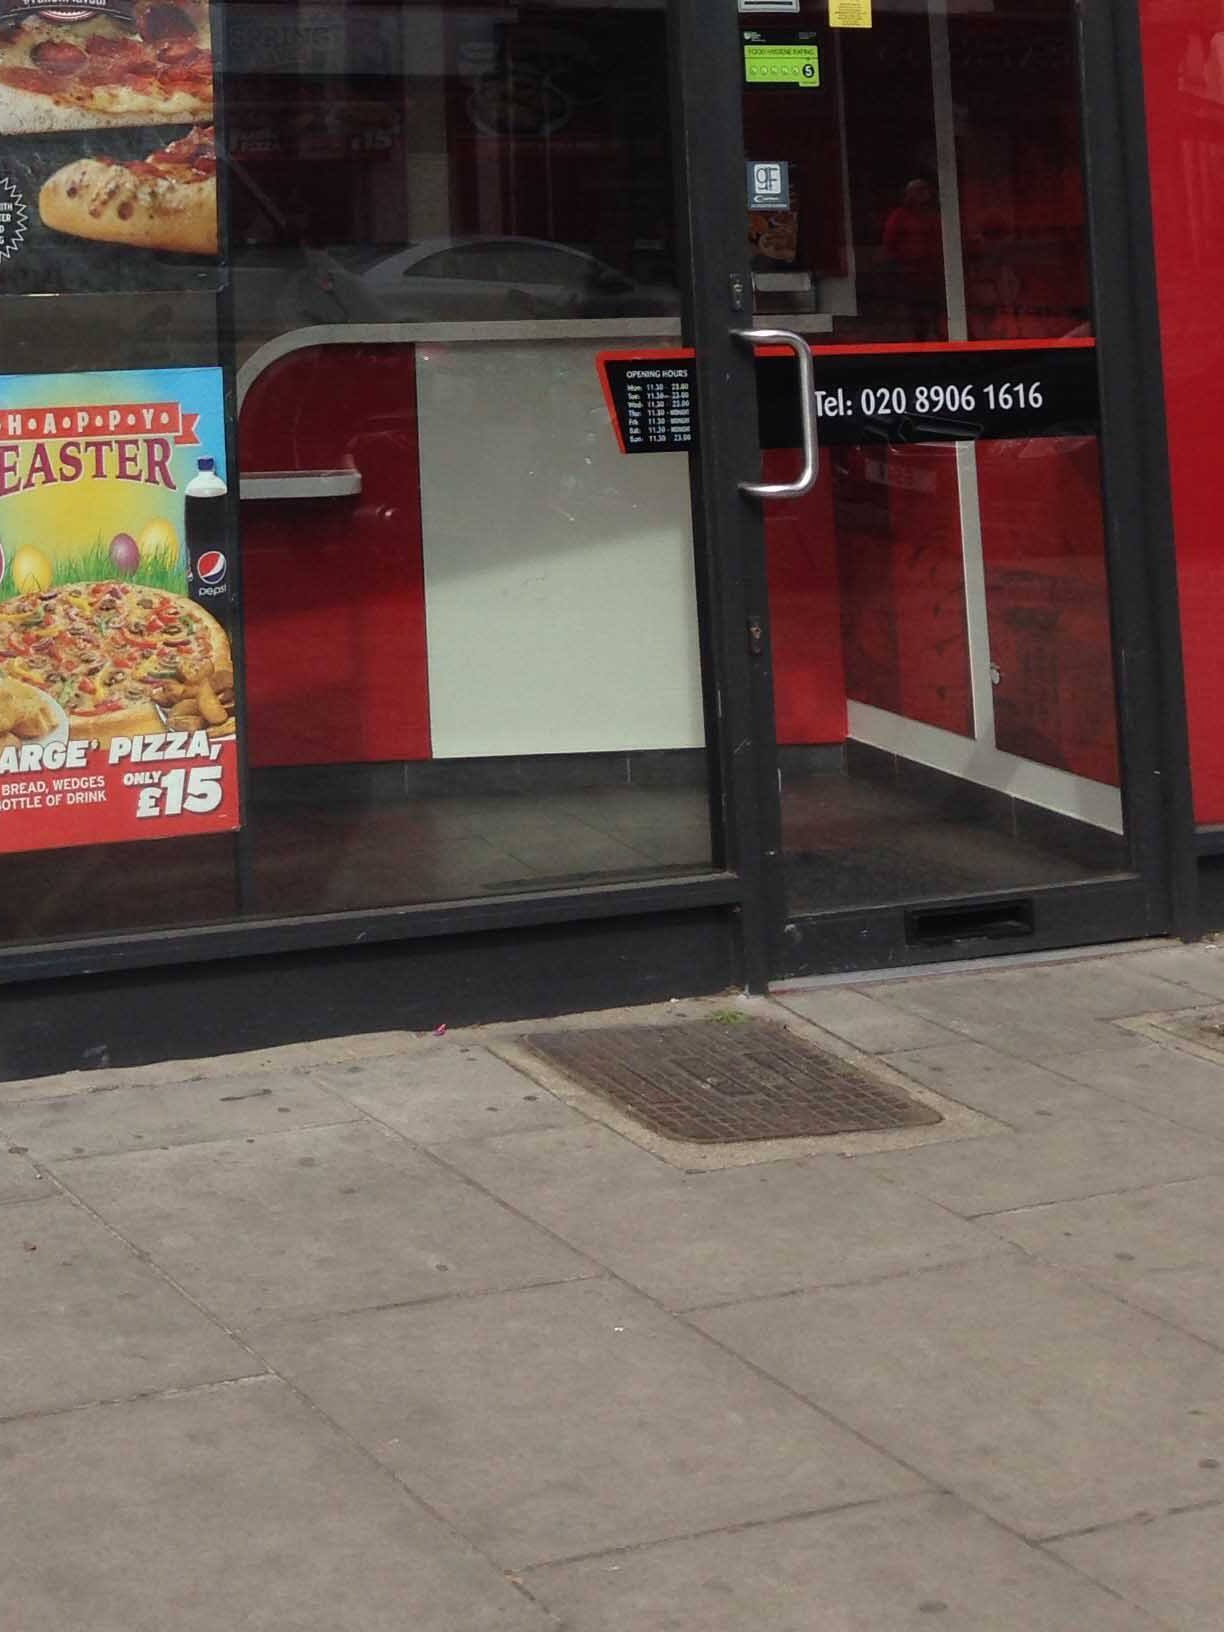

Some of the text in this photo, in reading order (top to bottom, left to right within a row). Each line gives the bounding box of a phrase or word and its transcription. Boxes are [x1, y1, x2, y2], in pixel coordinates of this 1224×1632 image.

[626, 369, 688, 379] OPENING HOURS
[814, 381, 1044, 417] Tel: 020 8906 1616
[108, 729, 222, 765] PIZZA,
[1, 780, 49, 797] BREAD,
[52, 775, 105, 792] WEDGES
[46, 792, 63, 807] OF
[66, 788, 107, 805] DRINK
[123, 765, 223, 818] ONLY £15
